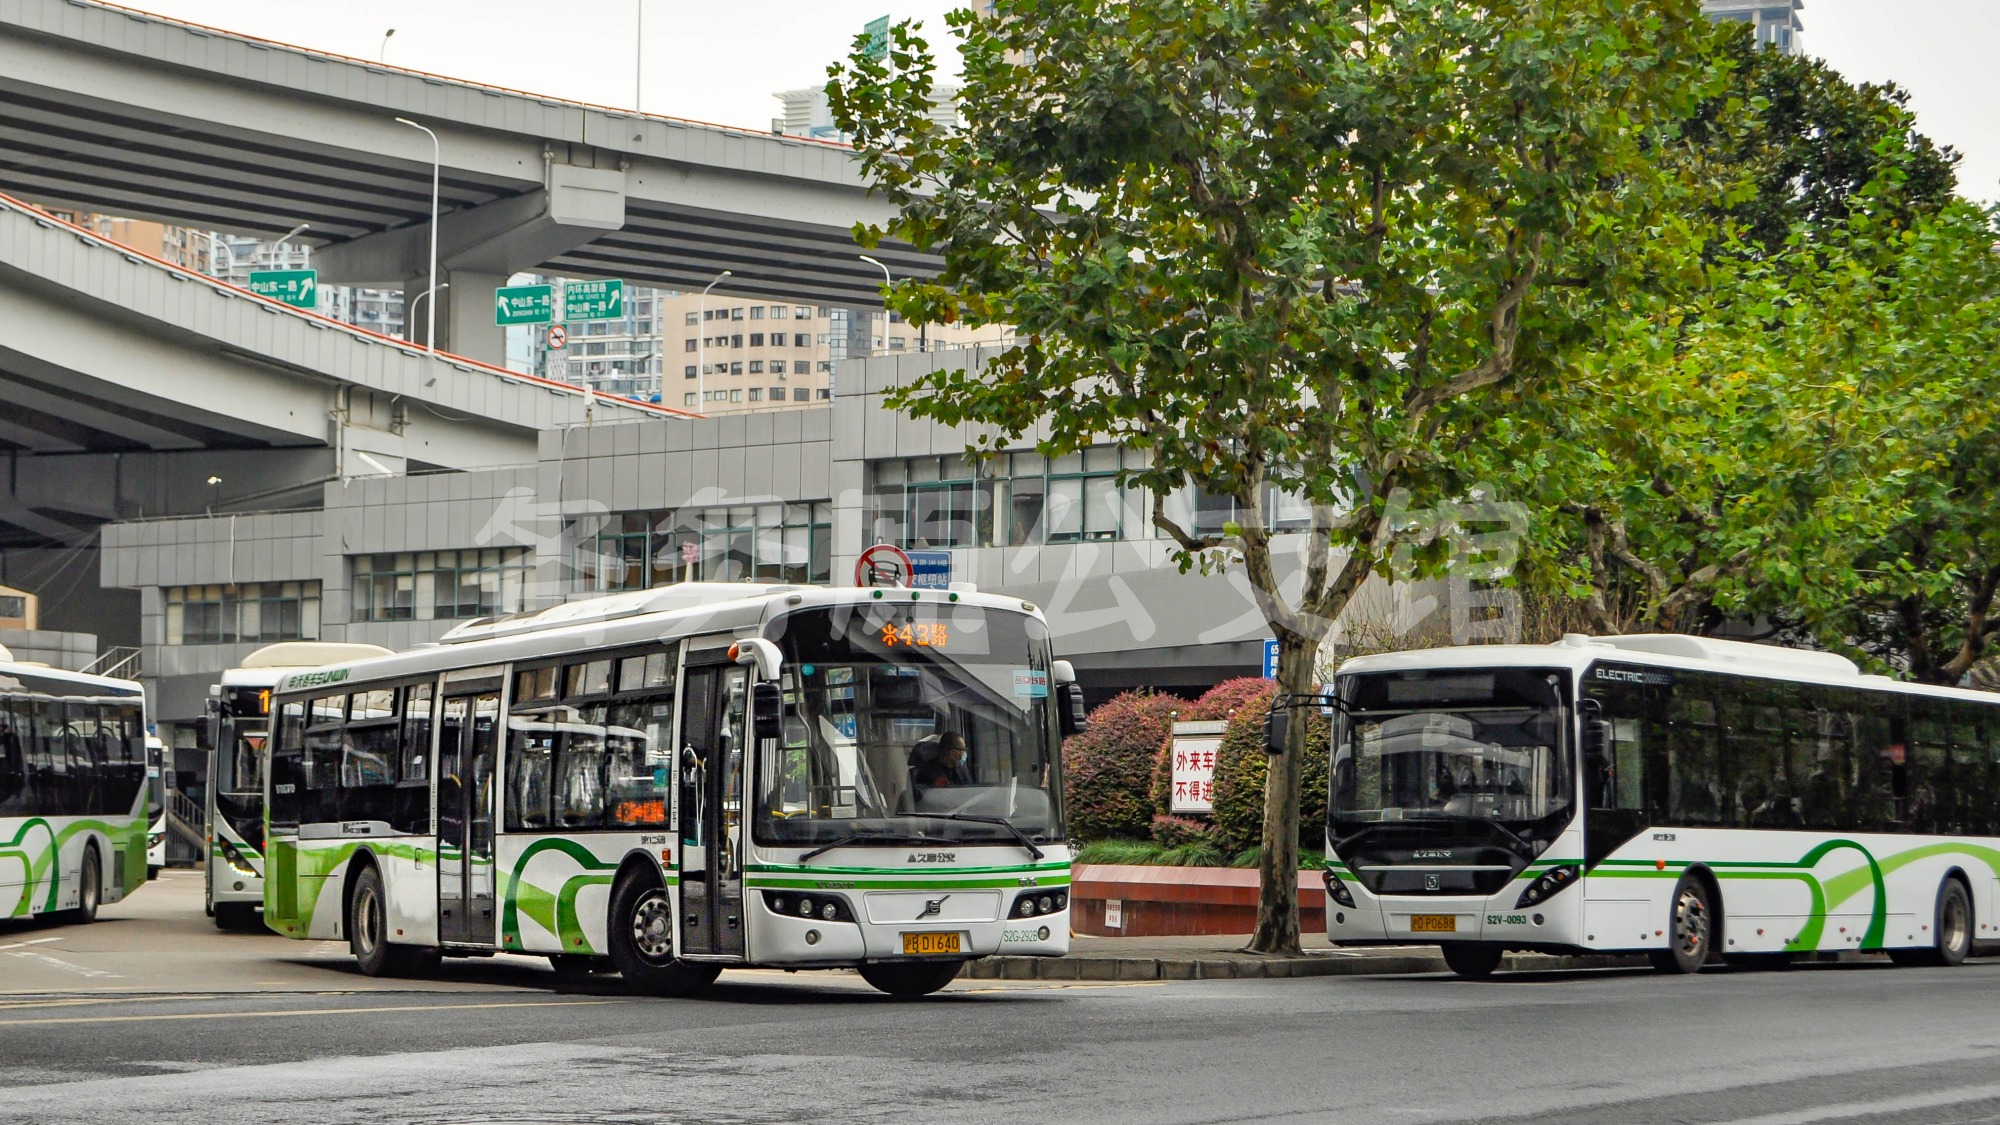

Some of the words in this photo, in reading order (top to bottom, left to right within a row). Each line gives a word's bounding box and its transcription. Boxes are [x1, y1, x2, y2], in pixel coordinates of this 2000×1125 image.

[1596, 668, 1643, 683] ELECTRIC
[1176, 750, 1213, 771] 外来车
[1487, 915, 1527, 924] S2V-0093
